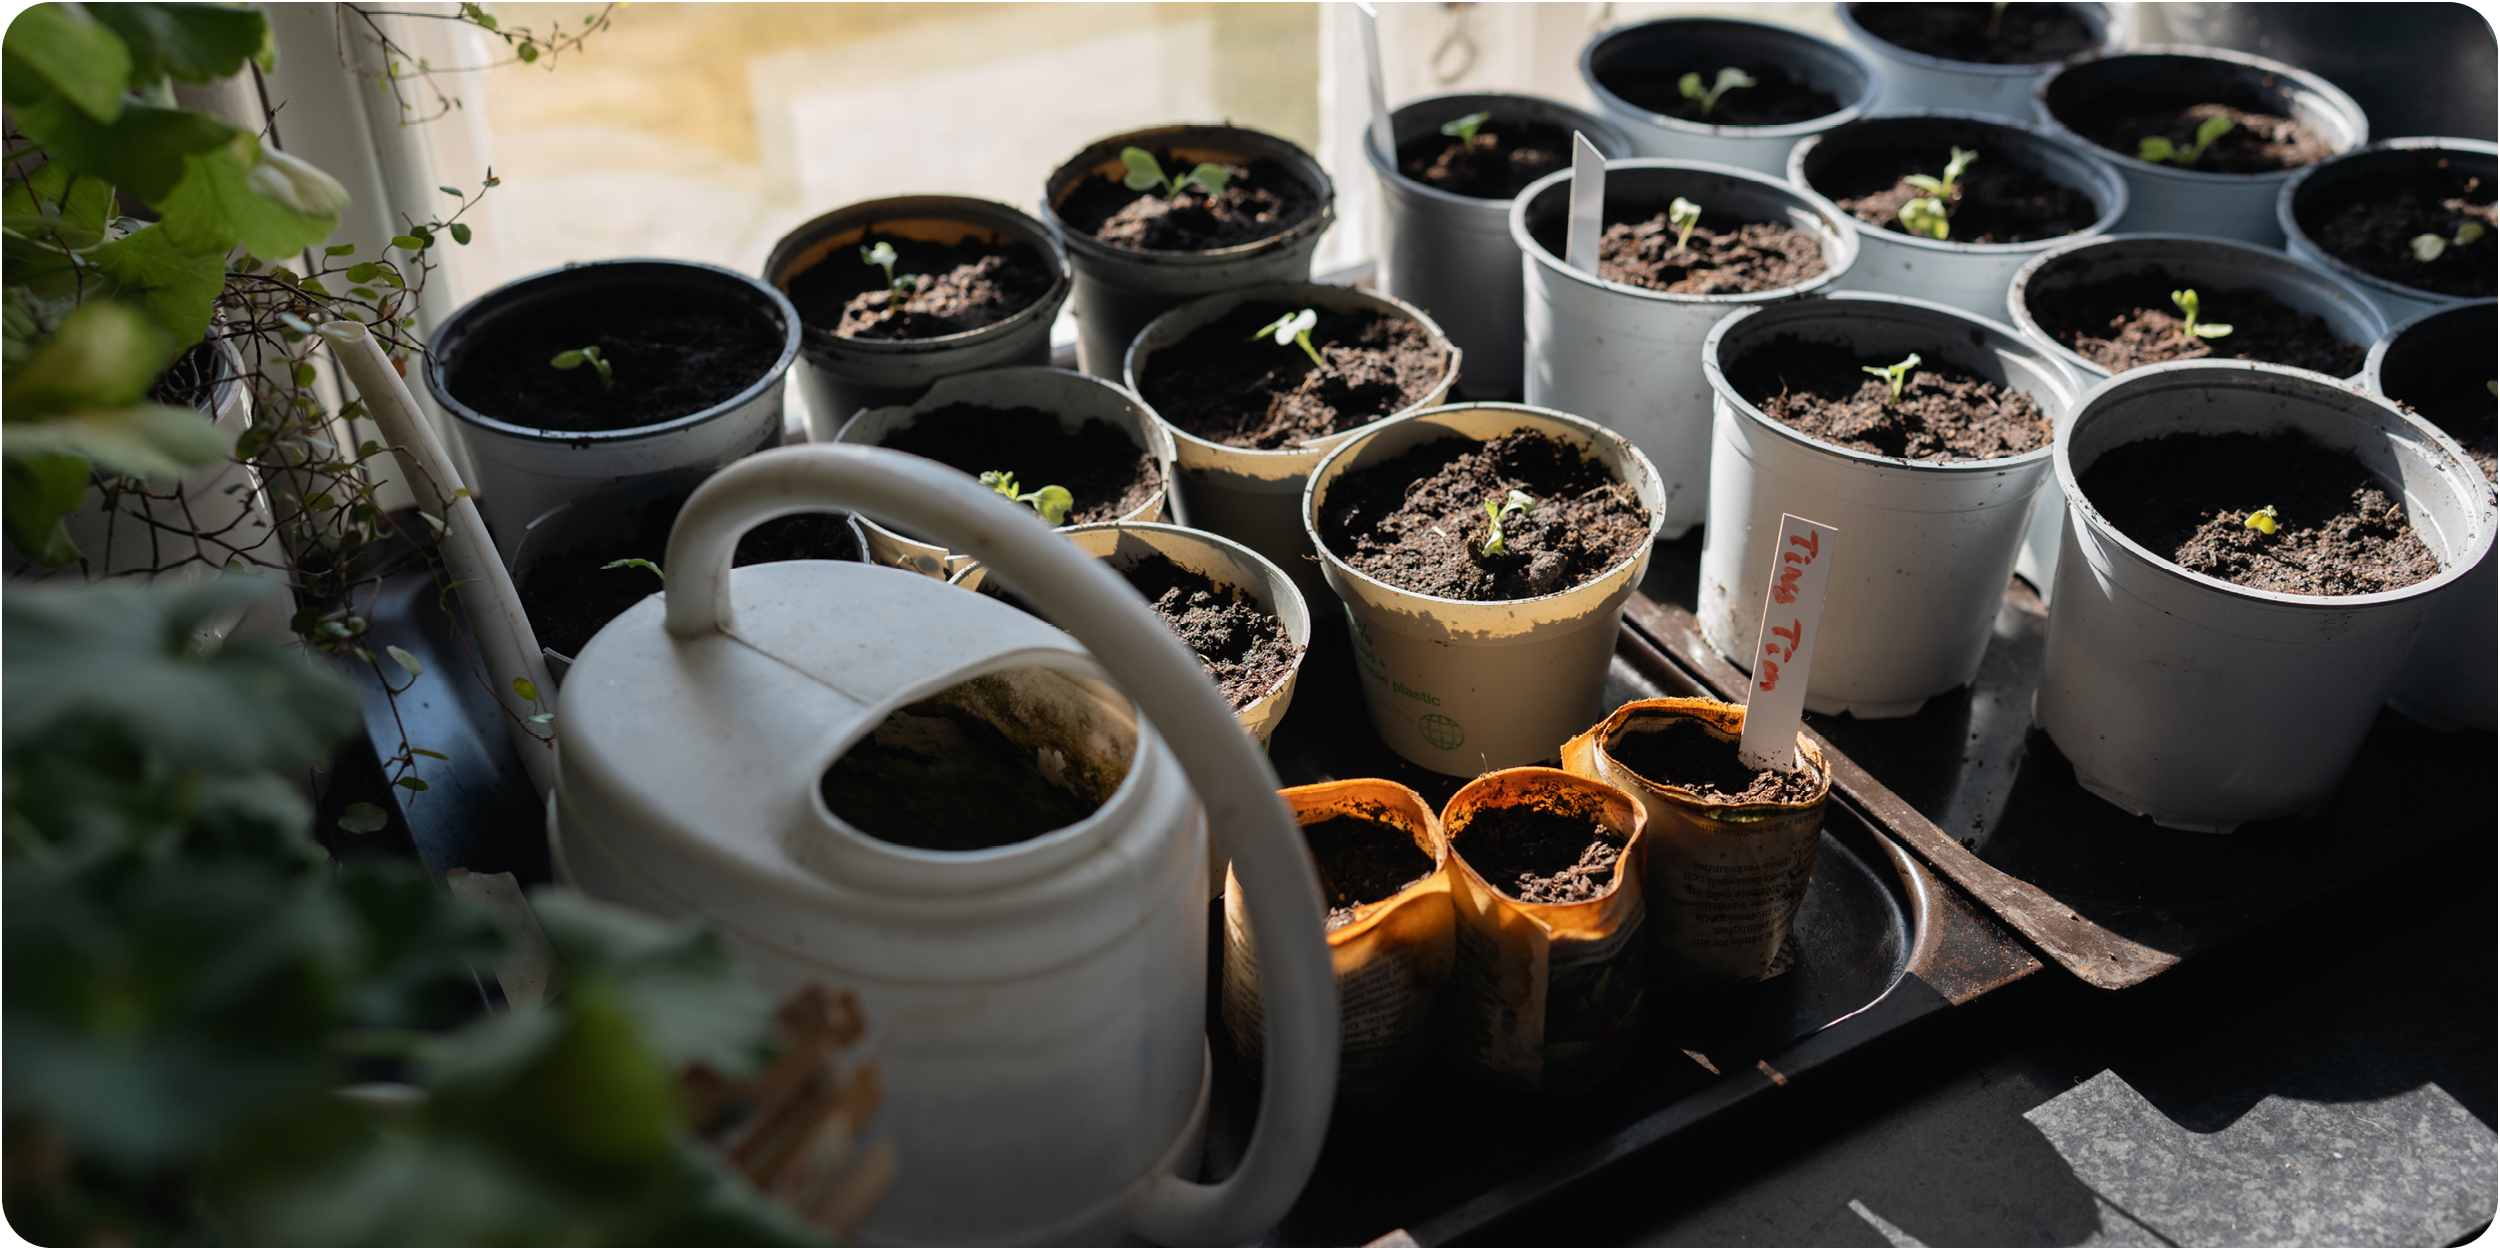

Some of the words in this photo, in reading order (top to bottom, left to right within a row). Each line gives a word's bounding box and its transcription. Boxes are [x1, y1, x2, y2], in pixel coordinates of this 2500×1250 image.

[1772, 529, 1819, 605] Tiny
[1758, 618, 1802, 692] Tim
[1392, 681, 1441, 706] plastic
[1701, 824, 1764, 838] vedmaskin
[1767, 820, 1792, 833] Pilke
[1693, 862, 1760, 874] verksamhet
[1763, 858, 1791, 870] deras
[1684, 871, 1704, 882] och
[1707, 890, 1732, 899] med
[1740, 902, 1747, 911] 6
[1695, 907, 1772, 924] professionella
[1692, 939, 1710, 948] sin
[1713, 939, 1728, 948] för
[1732, 934, 1764, 947] kända
